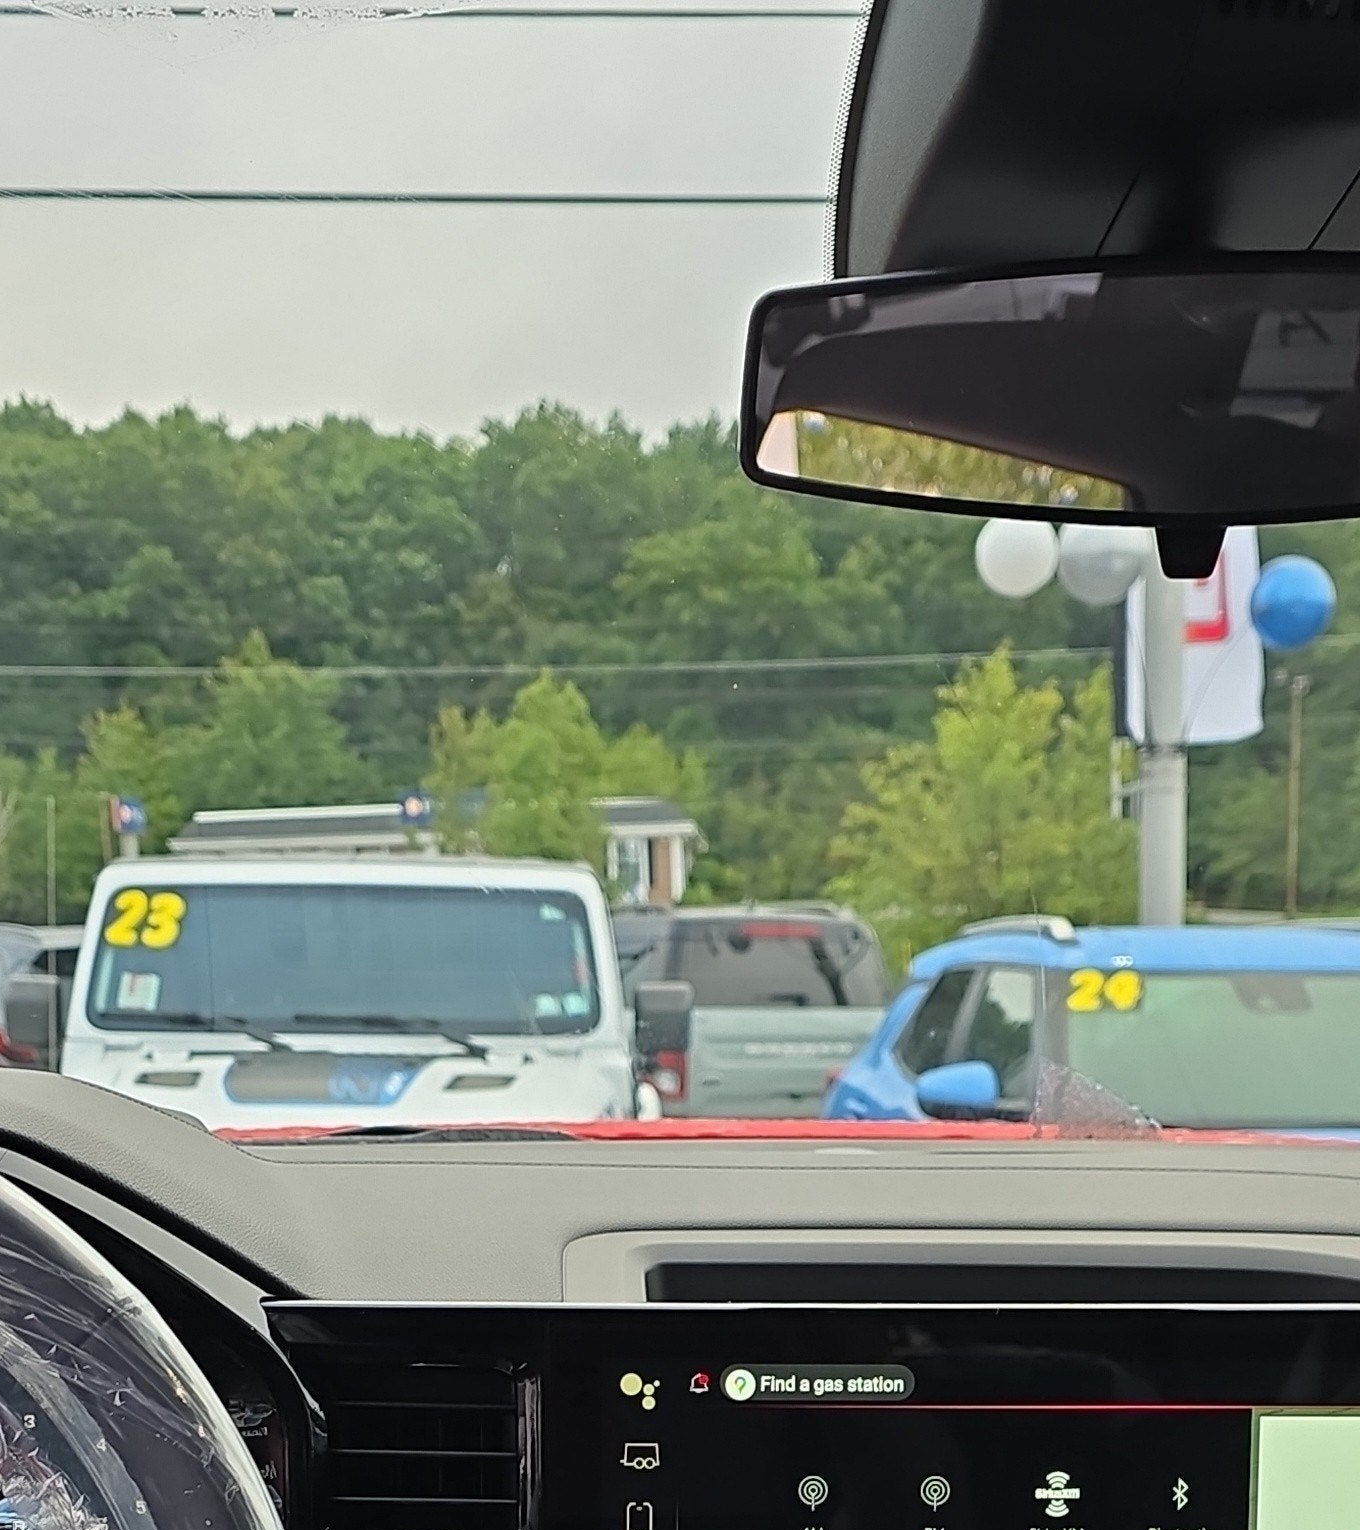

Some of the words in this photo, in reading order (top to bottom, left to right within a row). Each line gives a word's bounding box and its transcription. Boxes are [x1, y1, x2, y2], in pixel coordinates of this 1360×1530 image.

[103, 887, 187, 950] 23
[759, 1376, 794, 1393] Find
[799, 1381, 809, 1393] a
[814, 1379, 843, 1397] gas
[847, 1376, 904, 1393] station
[23, 1413, 36, 1429] 3
[136, 1499, 148, 1516] 5
